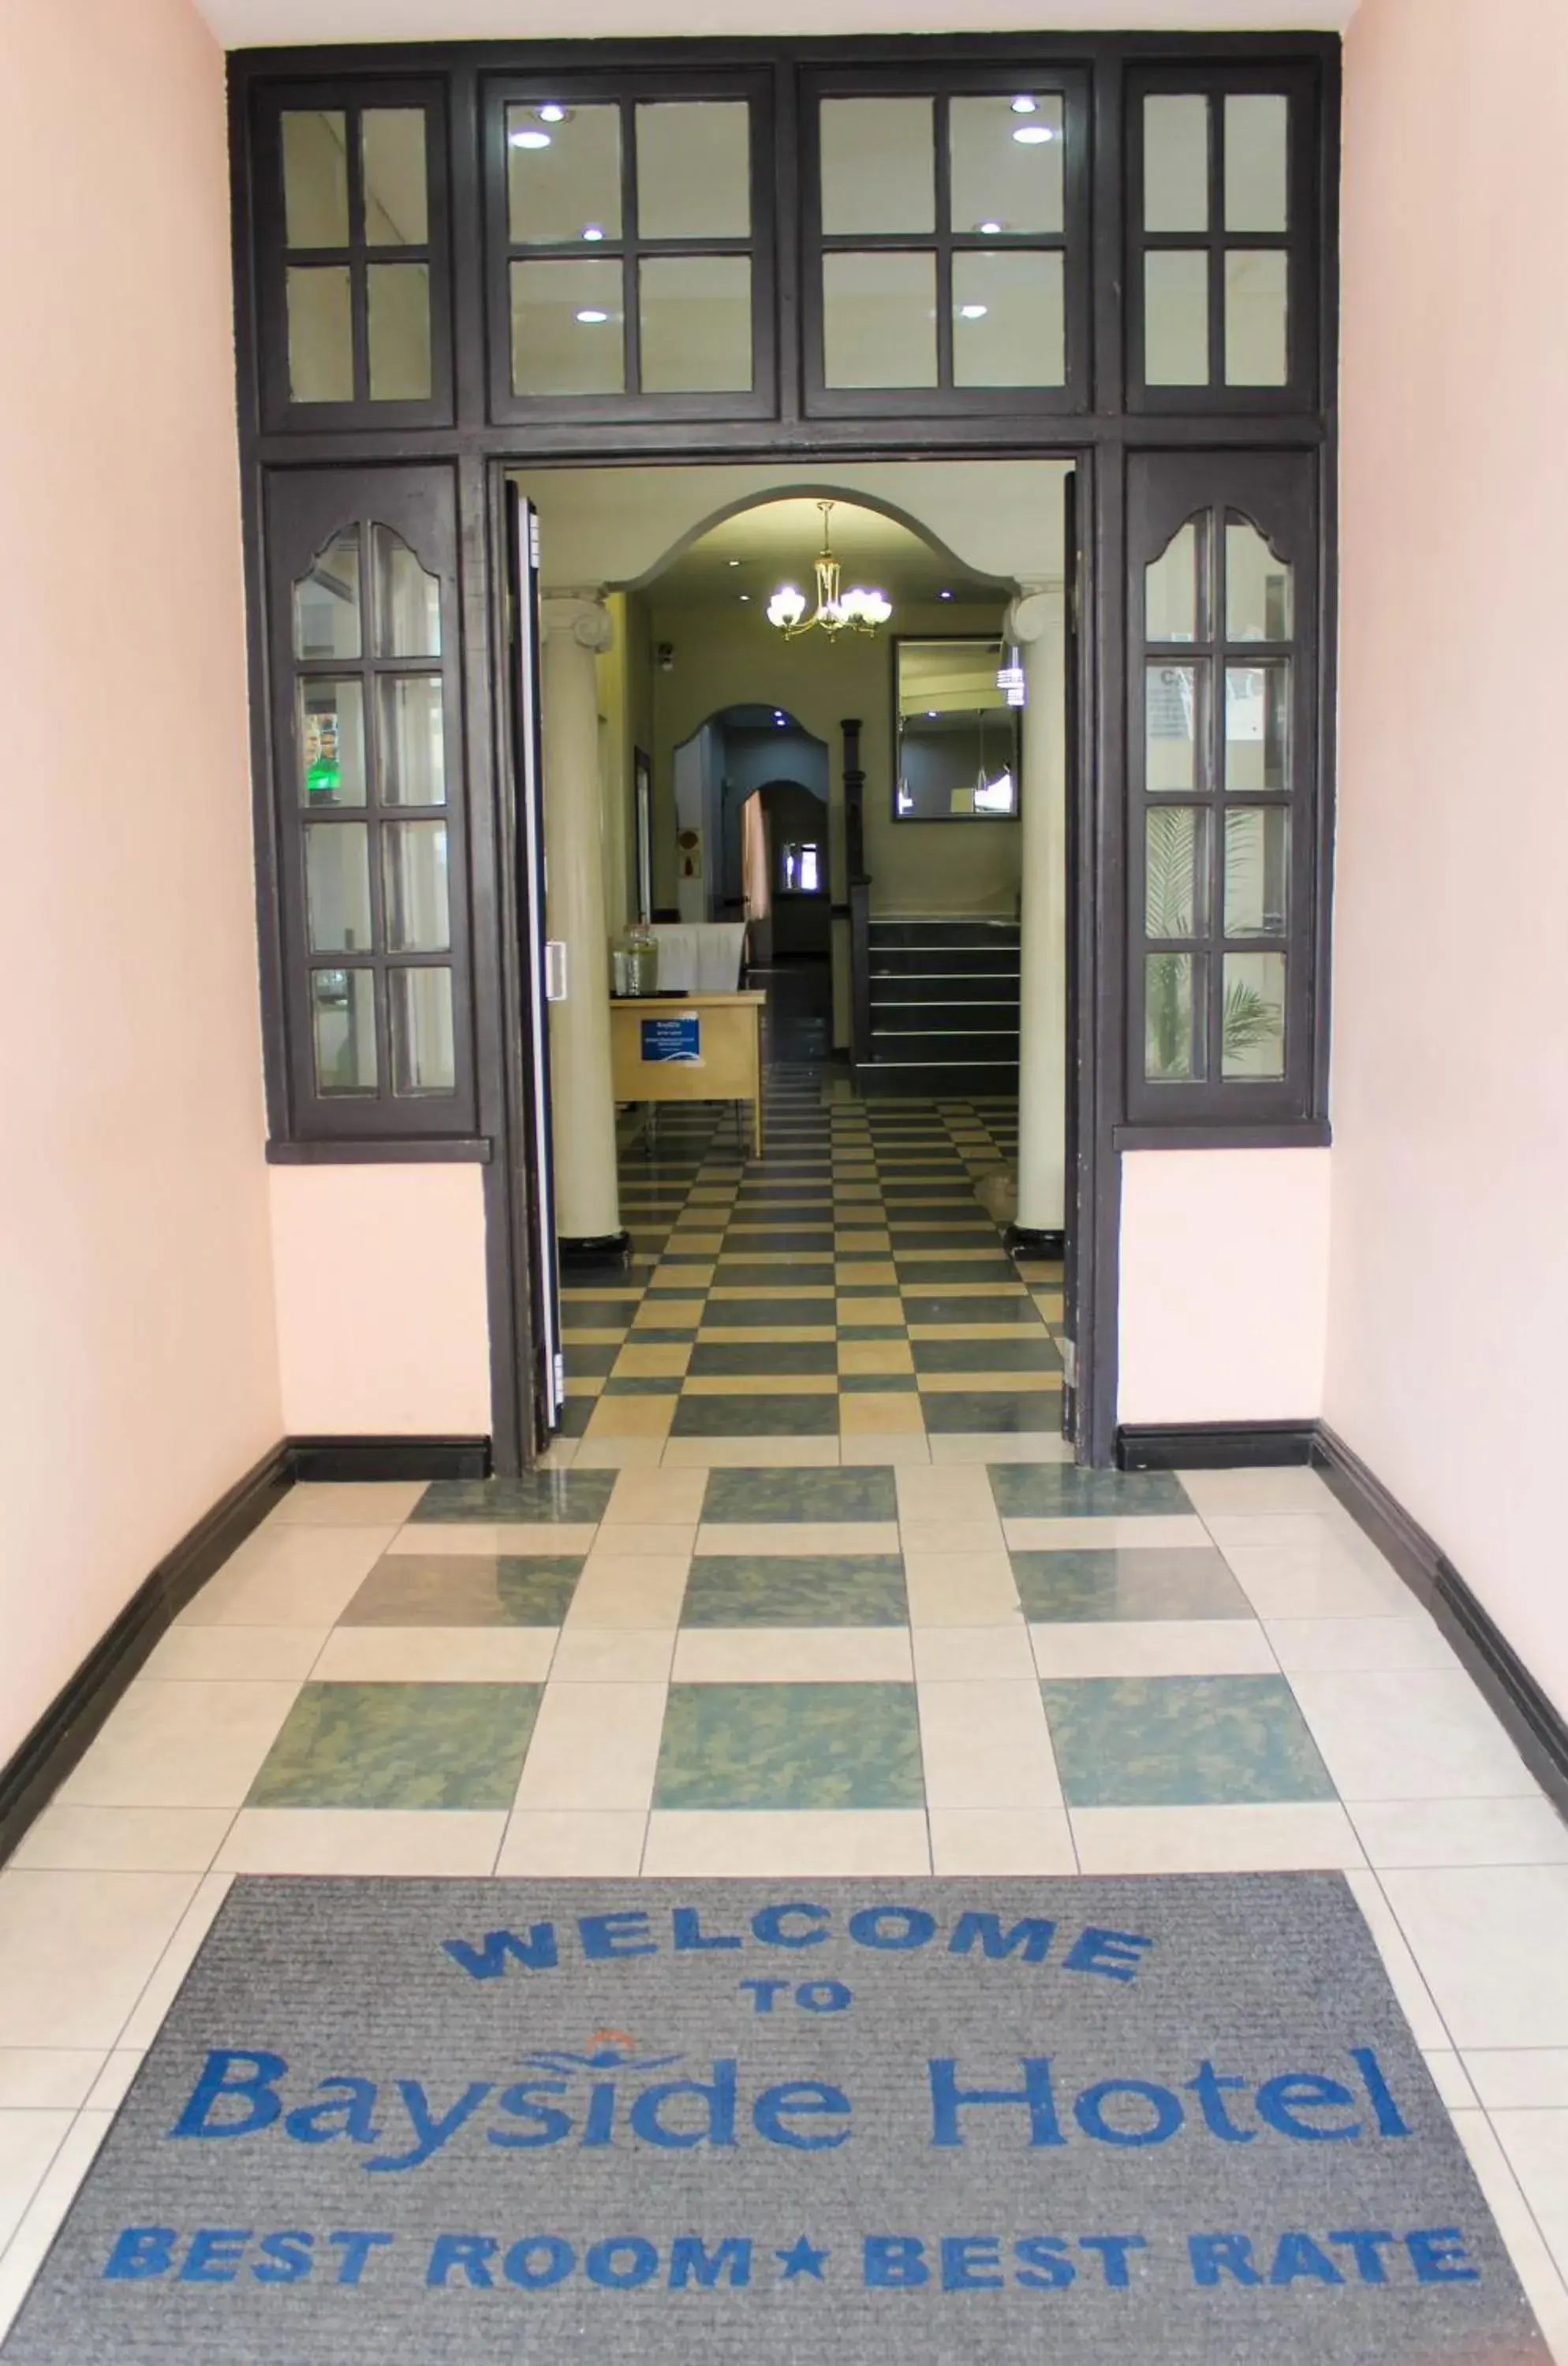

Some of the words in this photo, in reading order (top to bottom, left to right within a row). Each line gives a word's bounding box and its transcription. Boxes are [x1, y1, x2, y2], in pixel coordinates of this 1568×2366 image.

[443, 1902, 1154, 1982] WELCOME
[740, 1979, 852, 2013] TO
[168, 2049, 853, 2174] Bayside
[928, 2046, 1413, 2150] Hotel
[102, 2225, 392, 2287] BEST
[426, 2234, 753, 2292] ROOM
[862, 2234, 1147, 2293] BEST
[1186, 2225, 1480, 2291] RATE
